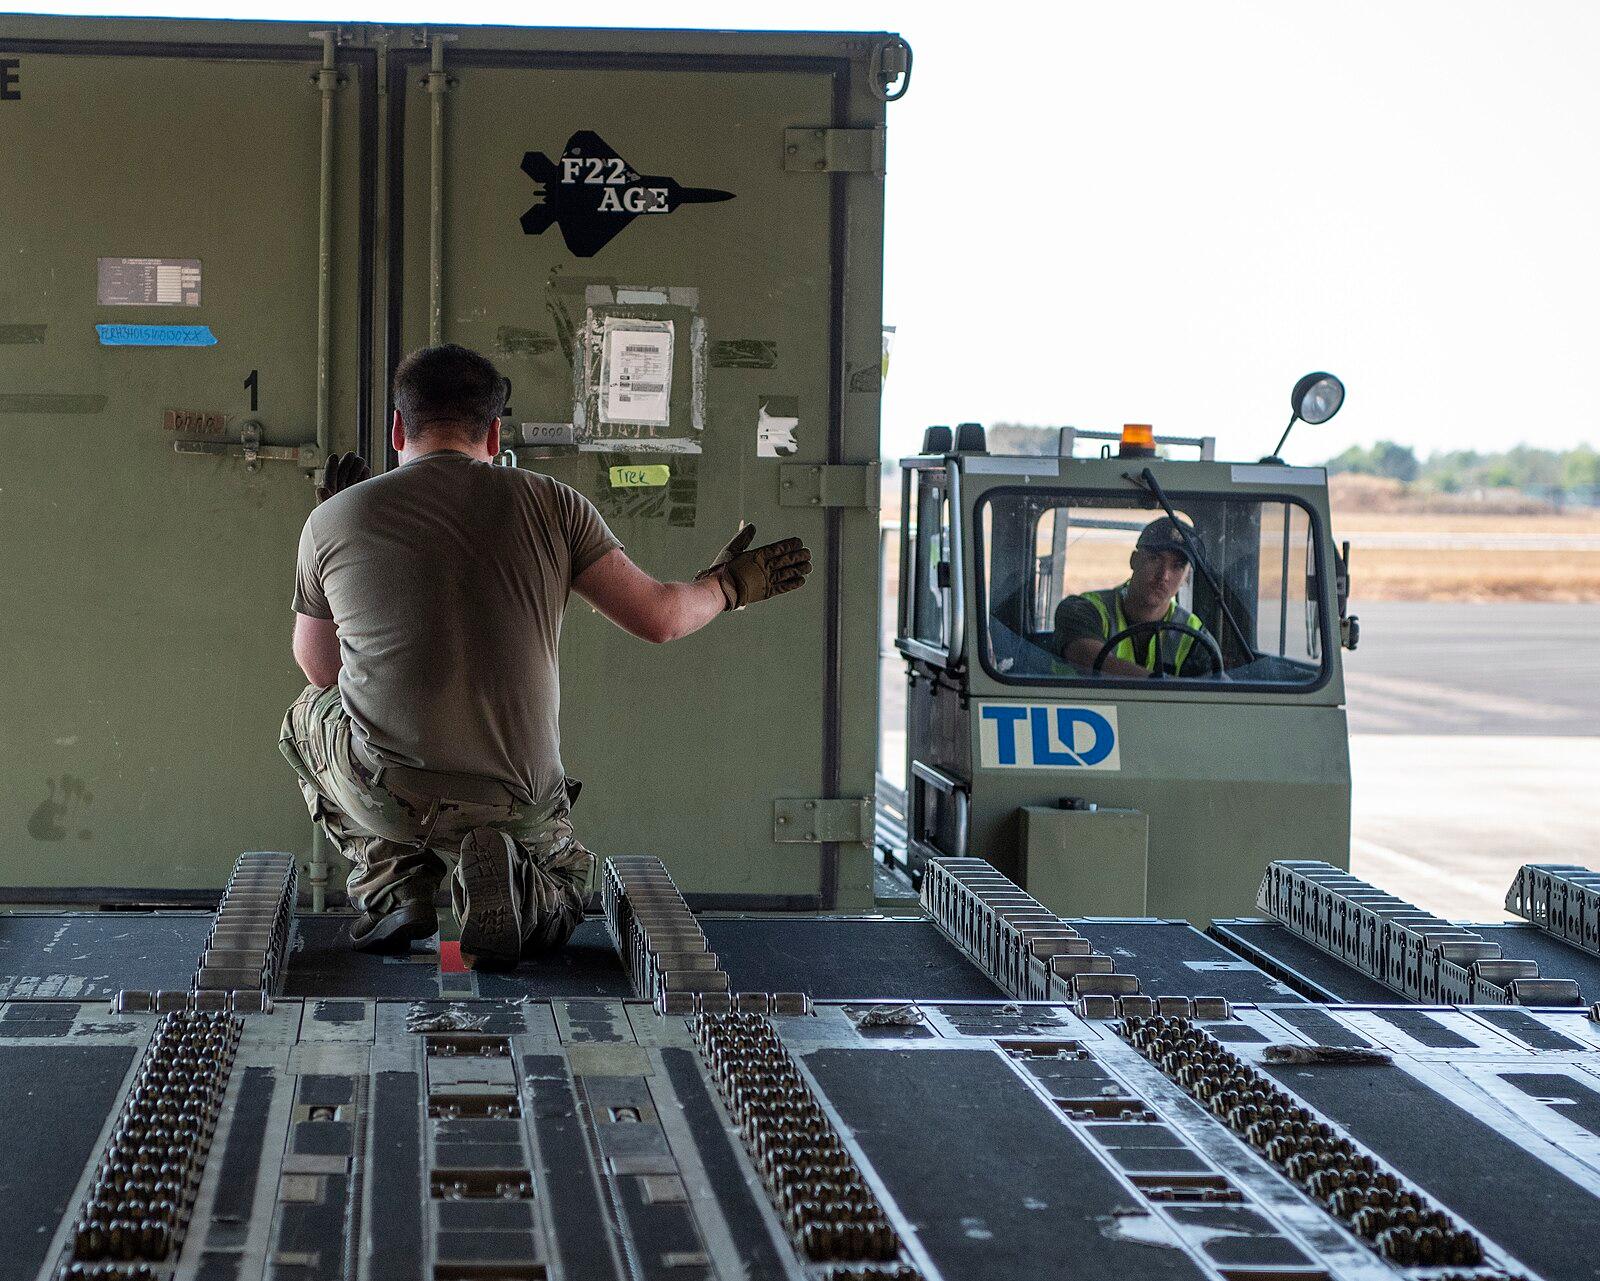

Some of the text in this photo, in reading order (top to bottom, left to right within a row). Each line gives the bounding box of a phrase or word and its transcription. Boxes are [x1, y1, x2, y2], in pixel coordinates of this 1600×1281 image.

[561, 158, 625, 184] F22
[598, 187, 668, 212] AGE
[244, 370, 257, 411] 1
[617, 469, 649, 484] Trek
[983, 707, 1114, 766] TLD
